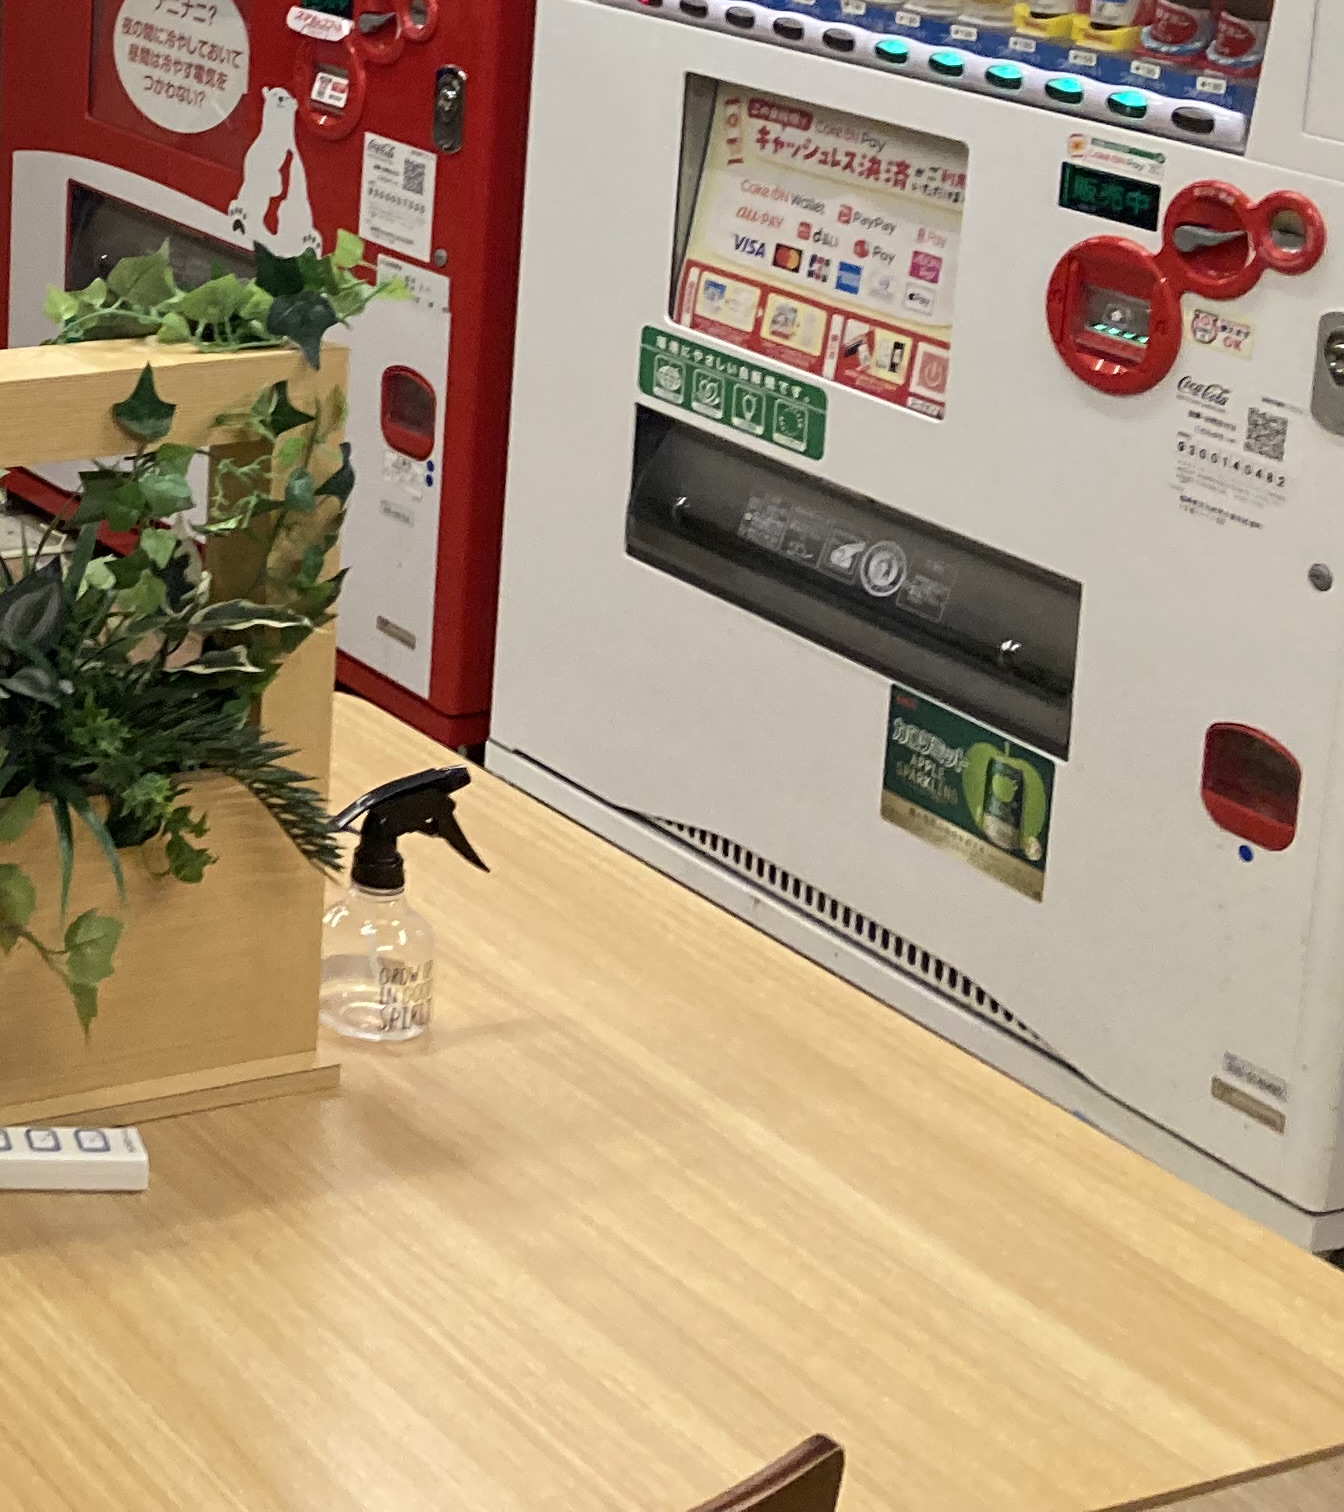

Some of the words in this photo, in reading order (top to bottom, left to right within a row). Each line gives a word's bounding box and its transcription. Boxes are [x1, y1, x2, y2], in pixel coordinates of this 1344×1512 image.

[143, 75, 206, 108] つかわない?
[861, 135, 887, 153] Pay
[755, 125, 911, 191] キャッシュレス決済
[852, 210, 898, 235] PayPay
[732, 233, 766, 259] VISA
[871, 244, 896, 264] Pay
